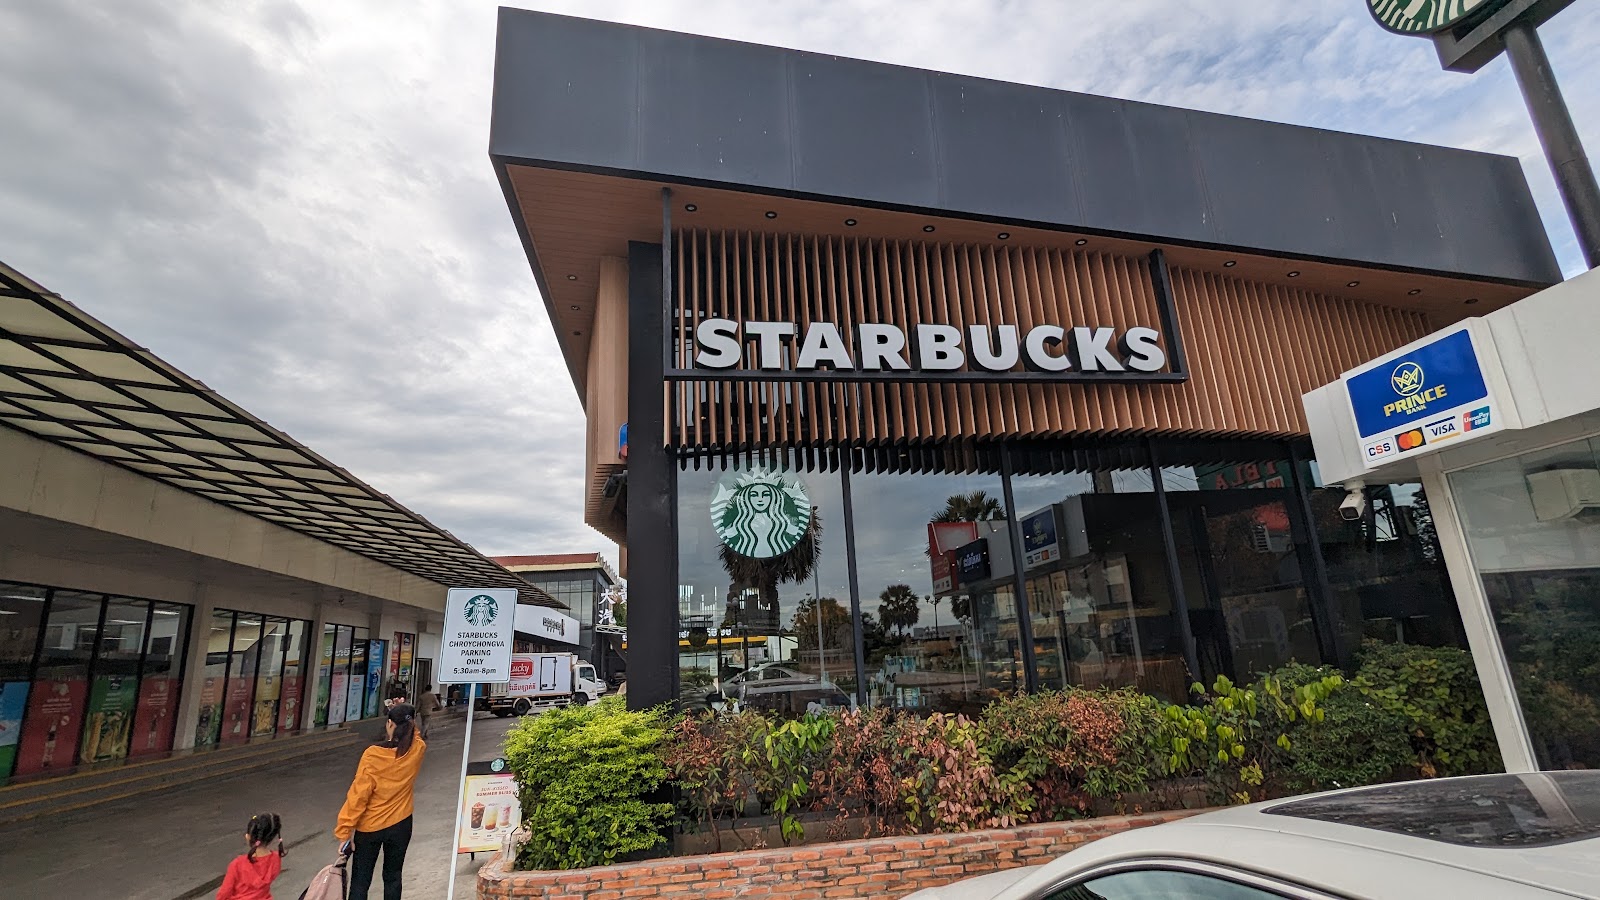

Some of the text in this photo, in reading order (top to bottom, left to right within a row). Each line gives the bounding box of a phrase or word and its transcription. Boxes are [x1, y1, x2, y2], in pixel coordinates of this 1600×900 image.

[695, 318, 1166, 373] STARBUCKS
[1383, 384, 1448, 417] PRINCE
[1406, 404, 1427, 416] BANK
[1368, 442, 1391, 457] CSS
[1431, 422, 1456, 437] VISA
[449, 640, 505, 648] CHROYCHONGVA
[453, 667, 497, 675] 5:30am-8pm
